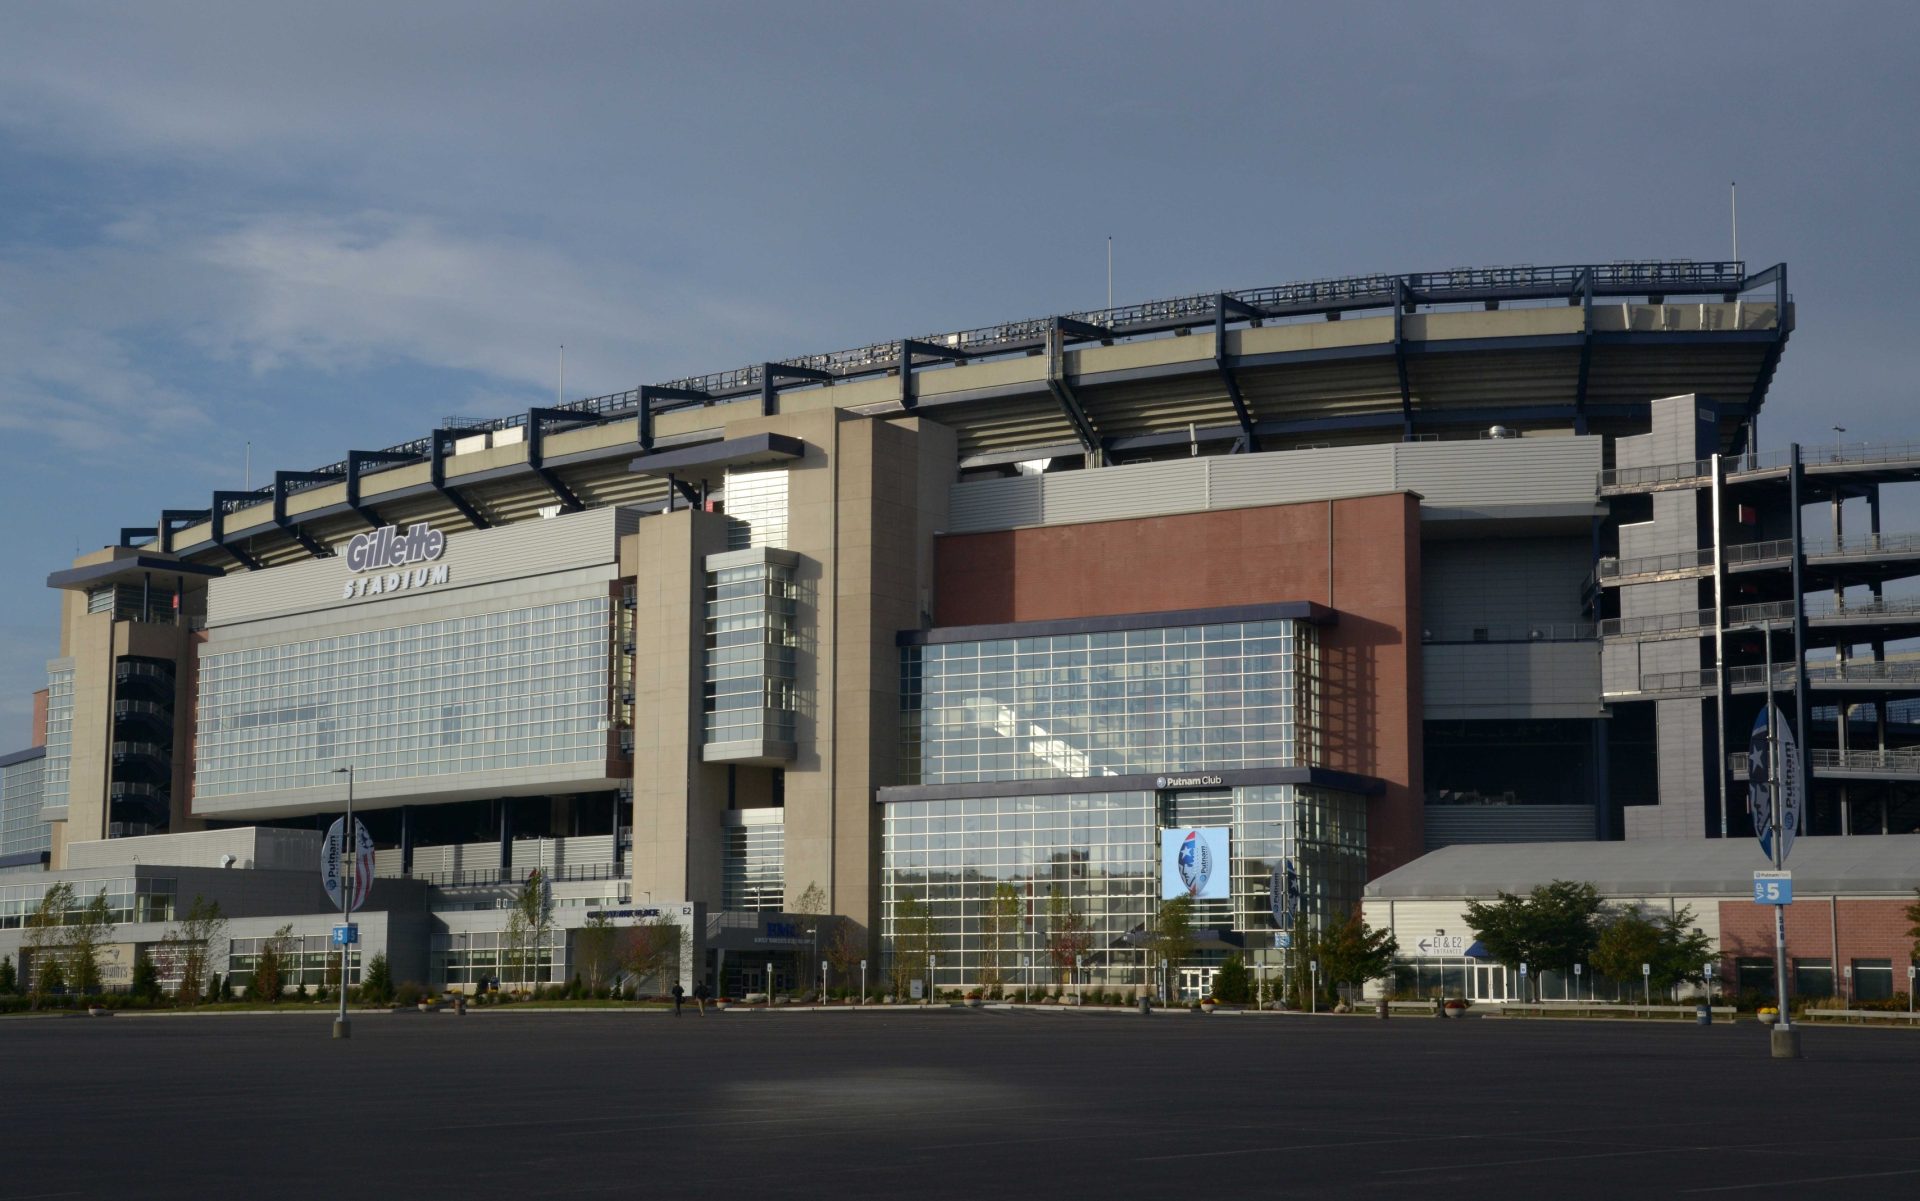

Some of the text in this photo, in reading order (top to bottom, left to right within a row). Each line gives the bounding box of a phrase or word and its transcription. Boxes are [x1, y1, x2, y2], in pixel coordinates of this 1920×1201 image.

[346, 522, 443, 573] Gillette
[343, 564, 448, 599] STADIUM
[1167, 775, 1222, 786] Putnam Club
[1784, 741, 1793, 808] Putnam
[328, 835, 337, 877] Putnam
[1755, 882, 1765, 900] VIP
[1766, 882, 1780, 900] 5
[682, 907, 692, 915] E2
[337, 929, 344, 941] 5
[1443, 936, 1451, 948] &
[1452, 936, 1462, 948] E2
